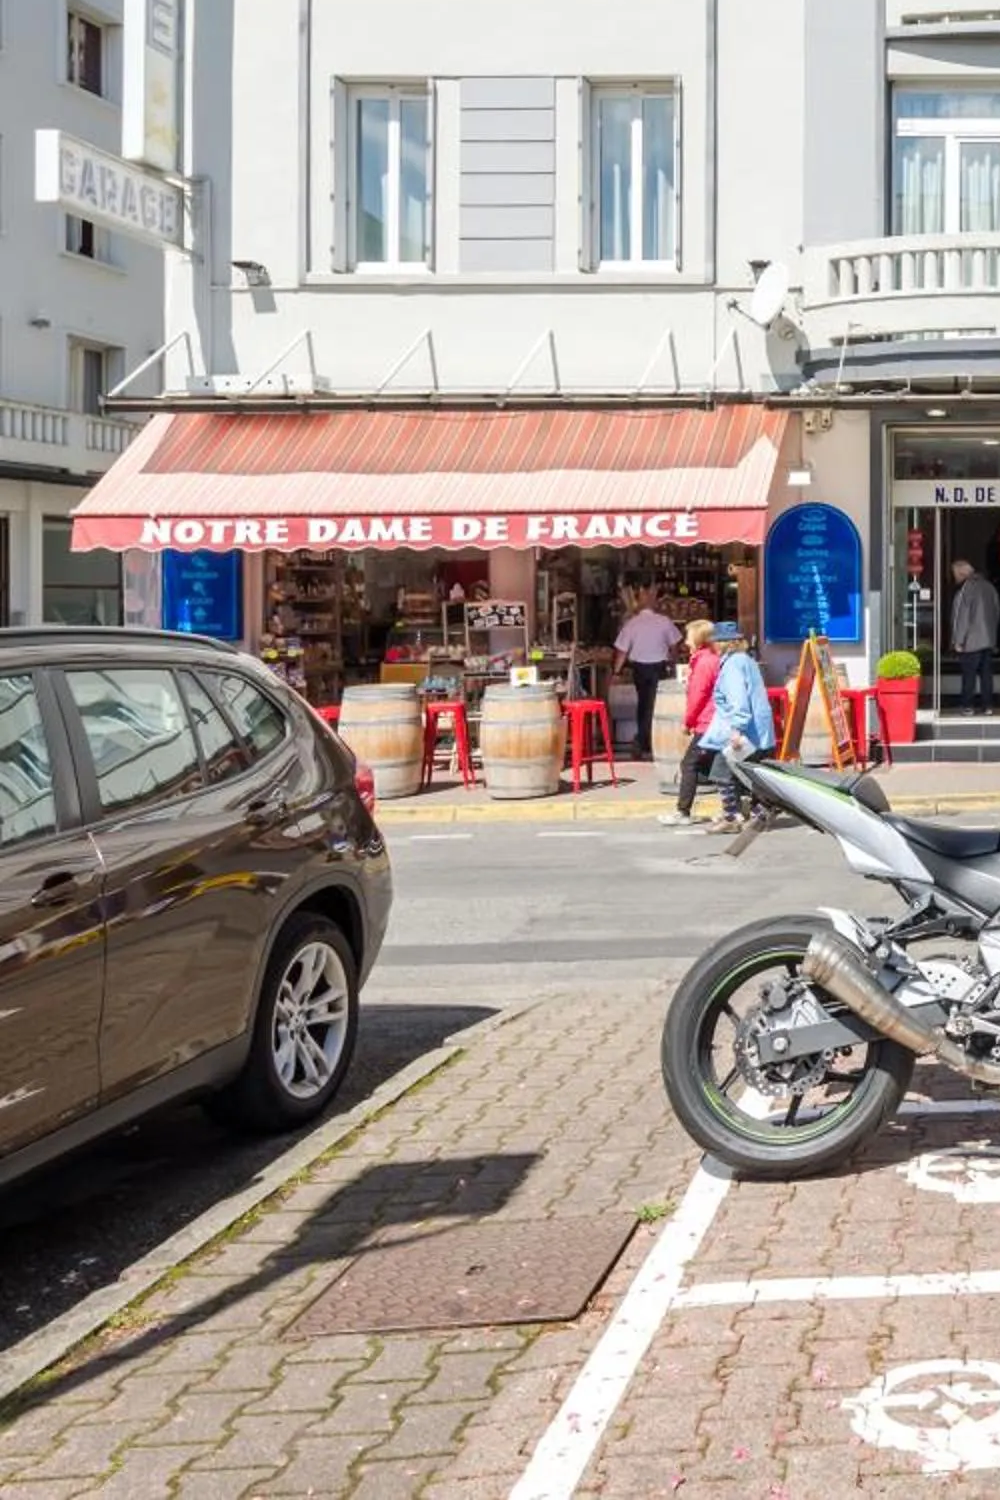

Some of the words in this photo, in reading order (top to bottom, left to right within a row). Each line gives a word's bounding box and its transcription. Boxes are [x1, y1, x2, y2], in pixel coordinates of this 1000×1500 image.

[60, 145, 177, 235] GARAGE
[975, 486, 997, 503] DE
[140, 518, 289, 545] NOTRE
[308, 516, 434, 543] DAME
[452, 516, 509, 541] DE
[526, 513, 699, 540] FRANCE
